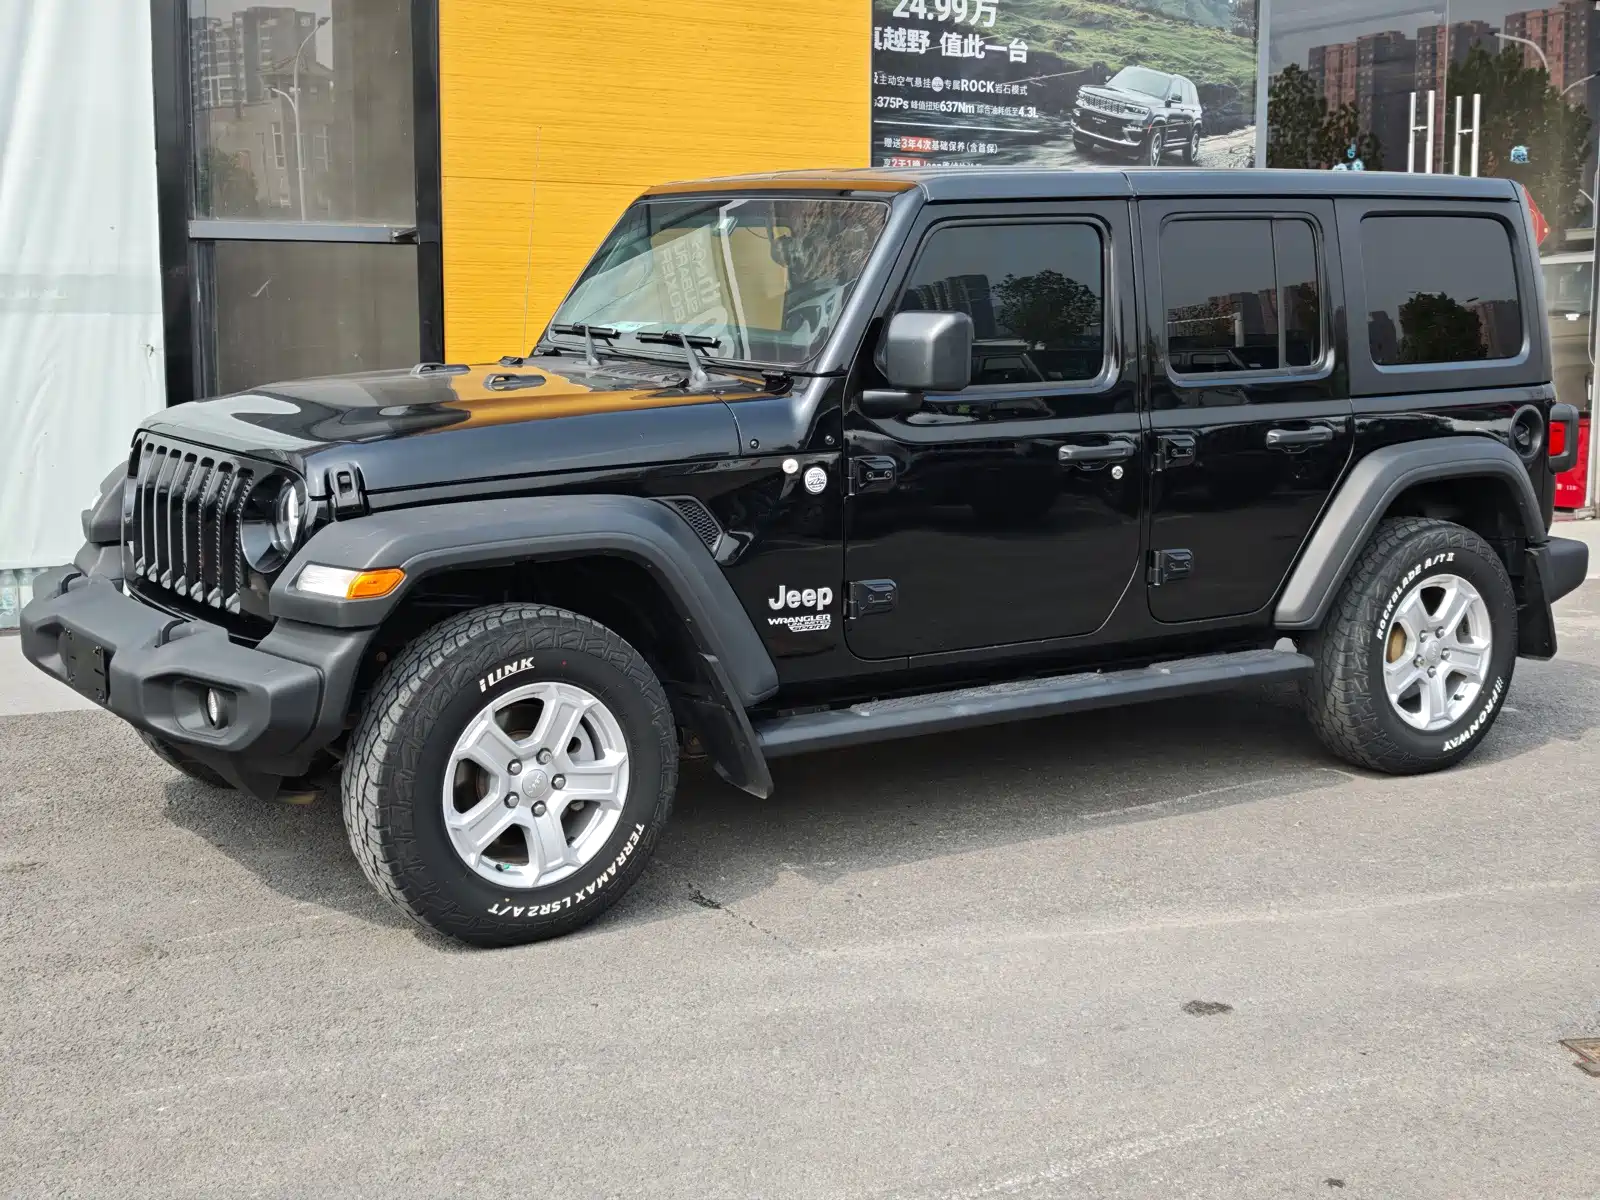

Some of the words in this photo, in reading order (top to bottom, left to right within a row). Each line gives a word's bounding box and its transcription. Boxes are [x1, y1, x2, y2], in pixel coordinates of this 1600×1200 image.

[939, 31, 1029, 63] 值此一台
[874, 95, 909, 110] 375Ps
[768, 584, 833, 611] Jeep
[1376, 563, 1422, 640] ROCKBLADE
[1424, 553, 1446, 569] A/T
[767, 613, 831, 626] WRANGLER
[790, 624, 830, 632] SPORT
[1442, 688, 1499, 752] FRONWAY
[575, 822, 645, 904] TERRAMAX
[488, 903, 525, 918] A/T
[527, 896, 571, 917] LSR2
